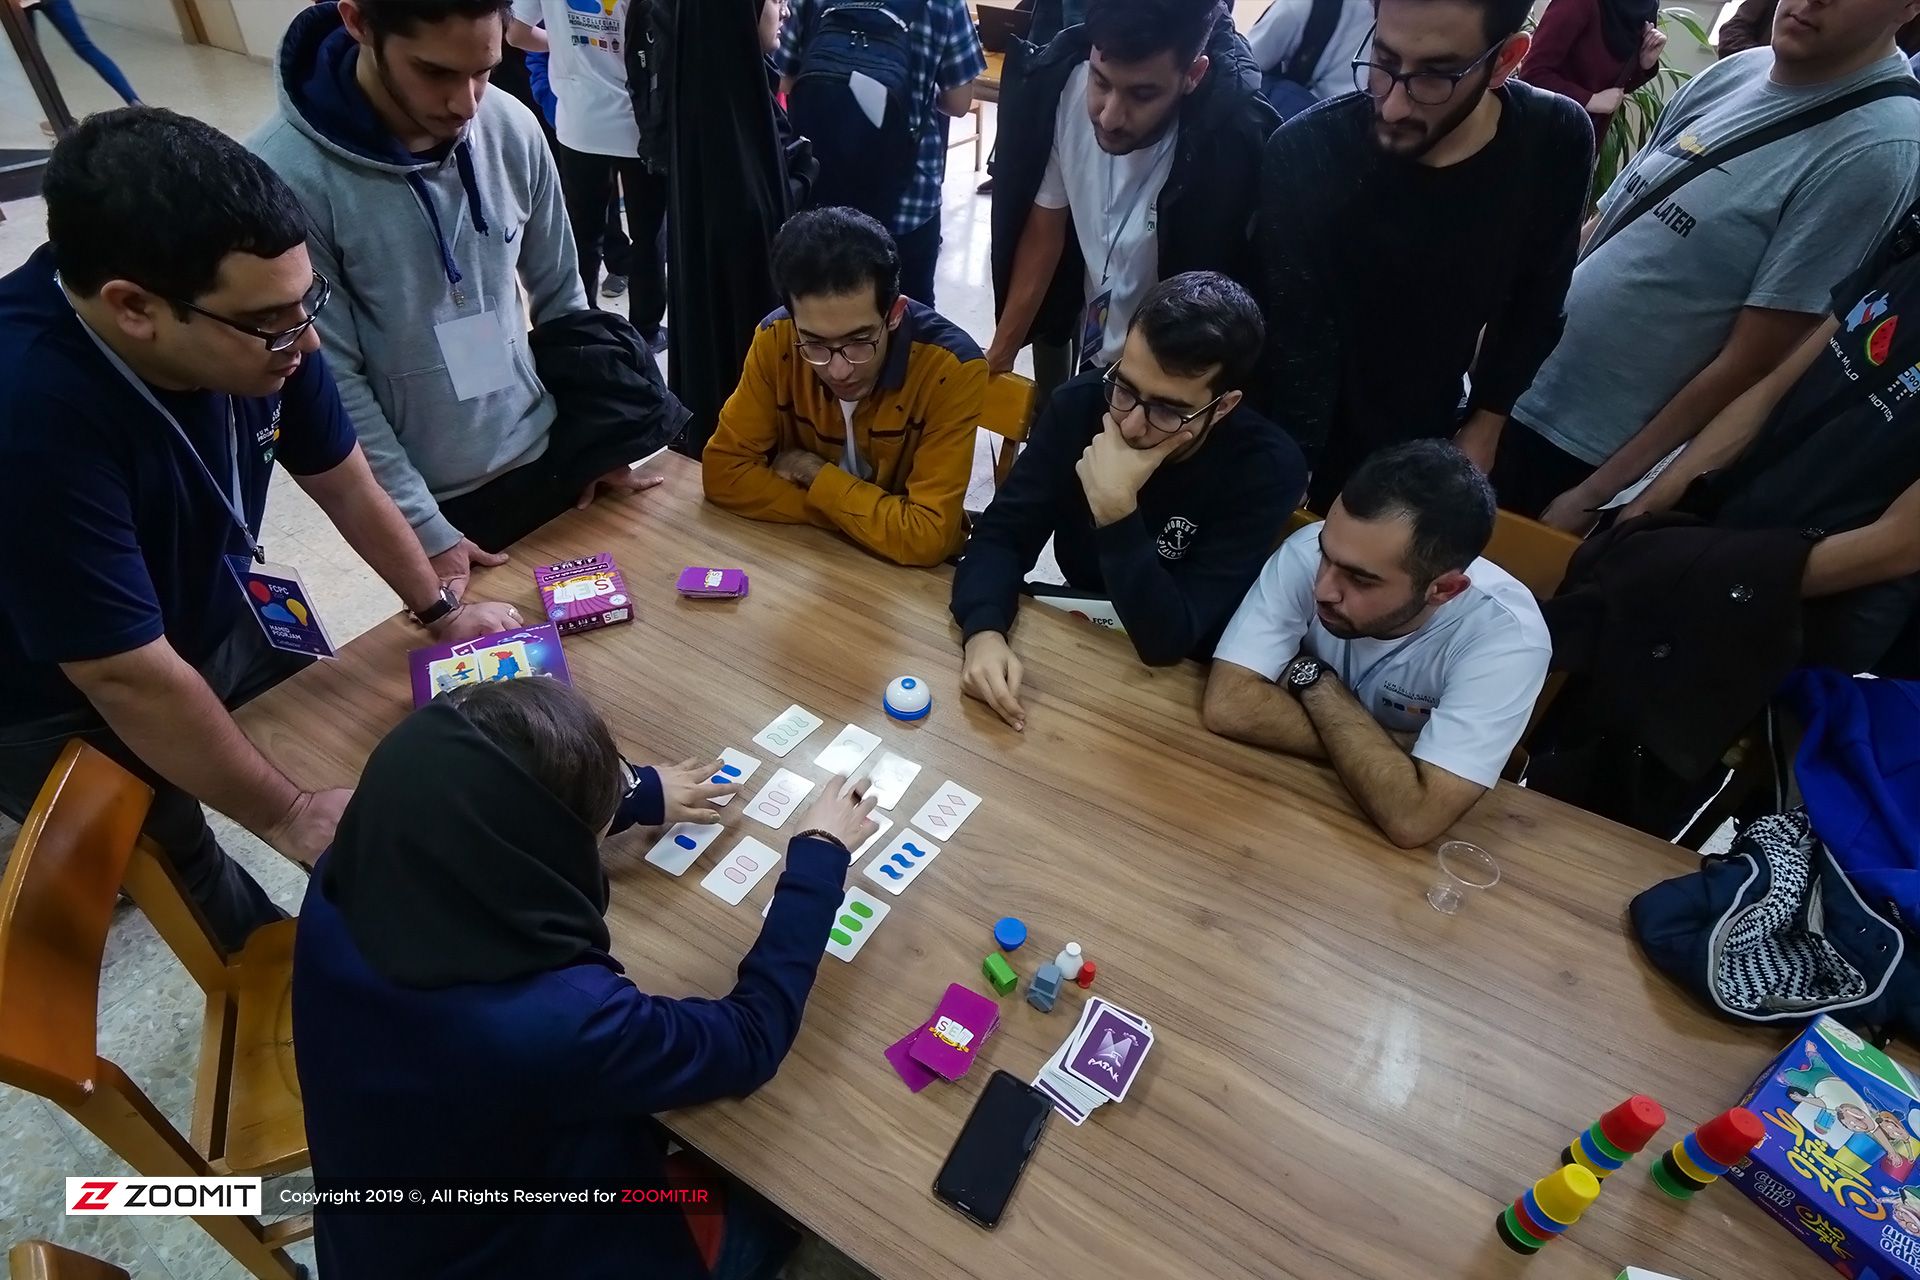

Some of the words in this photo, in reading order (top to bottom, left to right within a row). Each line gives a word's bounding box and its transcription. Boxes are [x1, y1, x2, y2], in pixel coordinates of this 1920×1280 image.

[1652, 198, 1697, 238] LATER
[268, 584, 289, 595] FCPC
[1087, 1057, 1120, 1083] PATAK
